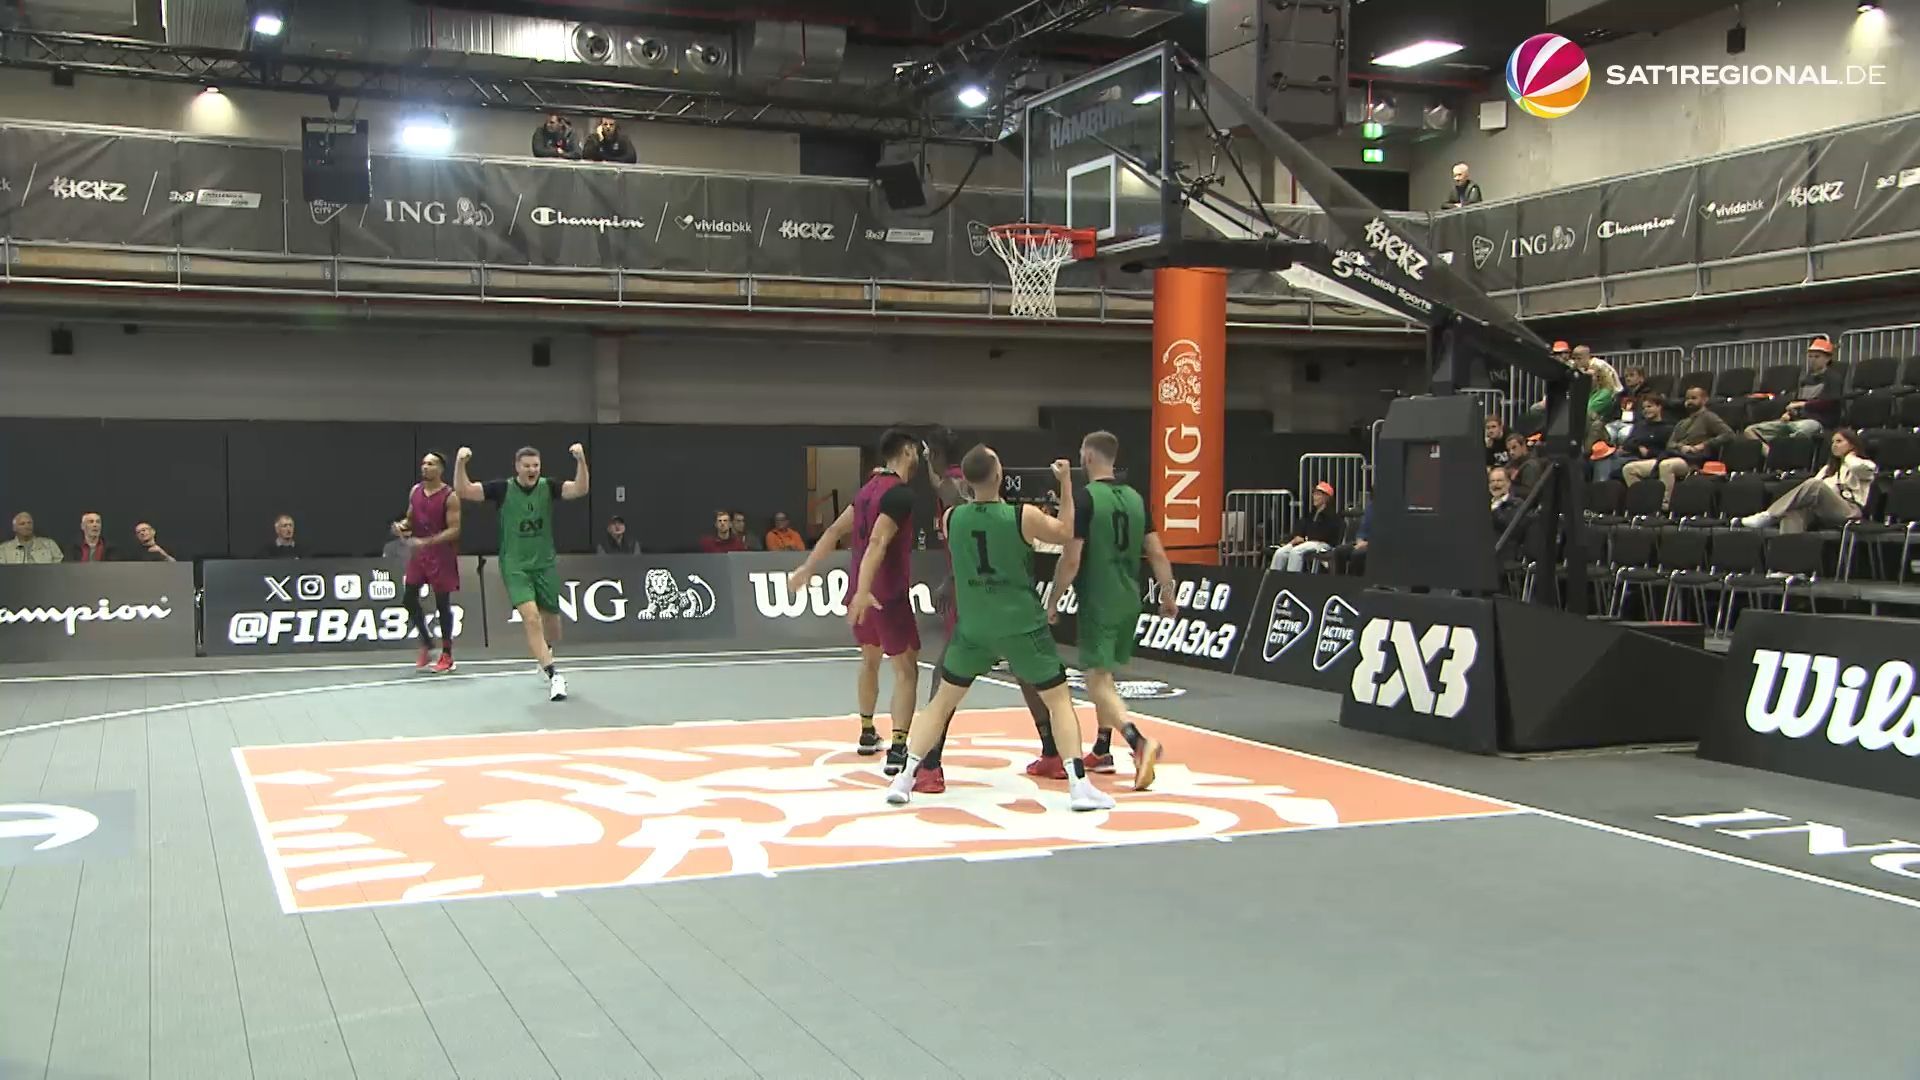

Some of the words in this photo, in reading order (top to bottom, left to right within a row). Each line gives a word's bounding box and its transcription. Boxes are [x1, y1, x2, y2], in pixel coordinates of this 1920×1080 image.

[384, 200, 447, 225] ING
[531, 206, 646, 233] Champion
[1715, 199, 1764, 218] vividabkk
[694, 219, 751, 233] vividabkk
[1597, 214, 1676, 238] Champion
[1511, 233, 1547, 258] ING
[1164, 423, 1202, 534] ING
[1112, 508, 1130, 553] 0
[971, 529, 997, 576] 1
[508, 579, 629, 623] NG
[749, 568, 936, 618] Wiln
[1269, 631, 1289, 645] CITY
[1272, 619, 1302, 635] ACTIVE
[1322, 625, 1355, 641] ACTIVE
[1319, 639, 1340, 653] CITY
